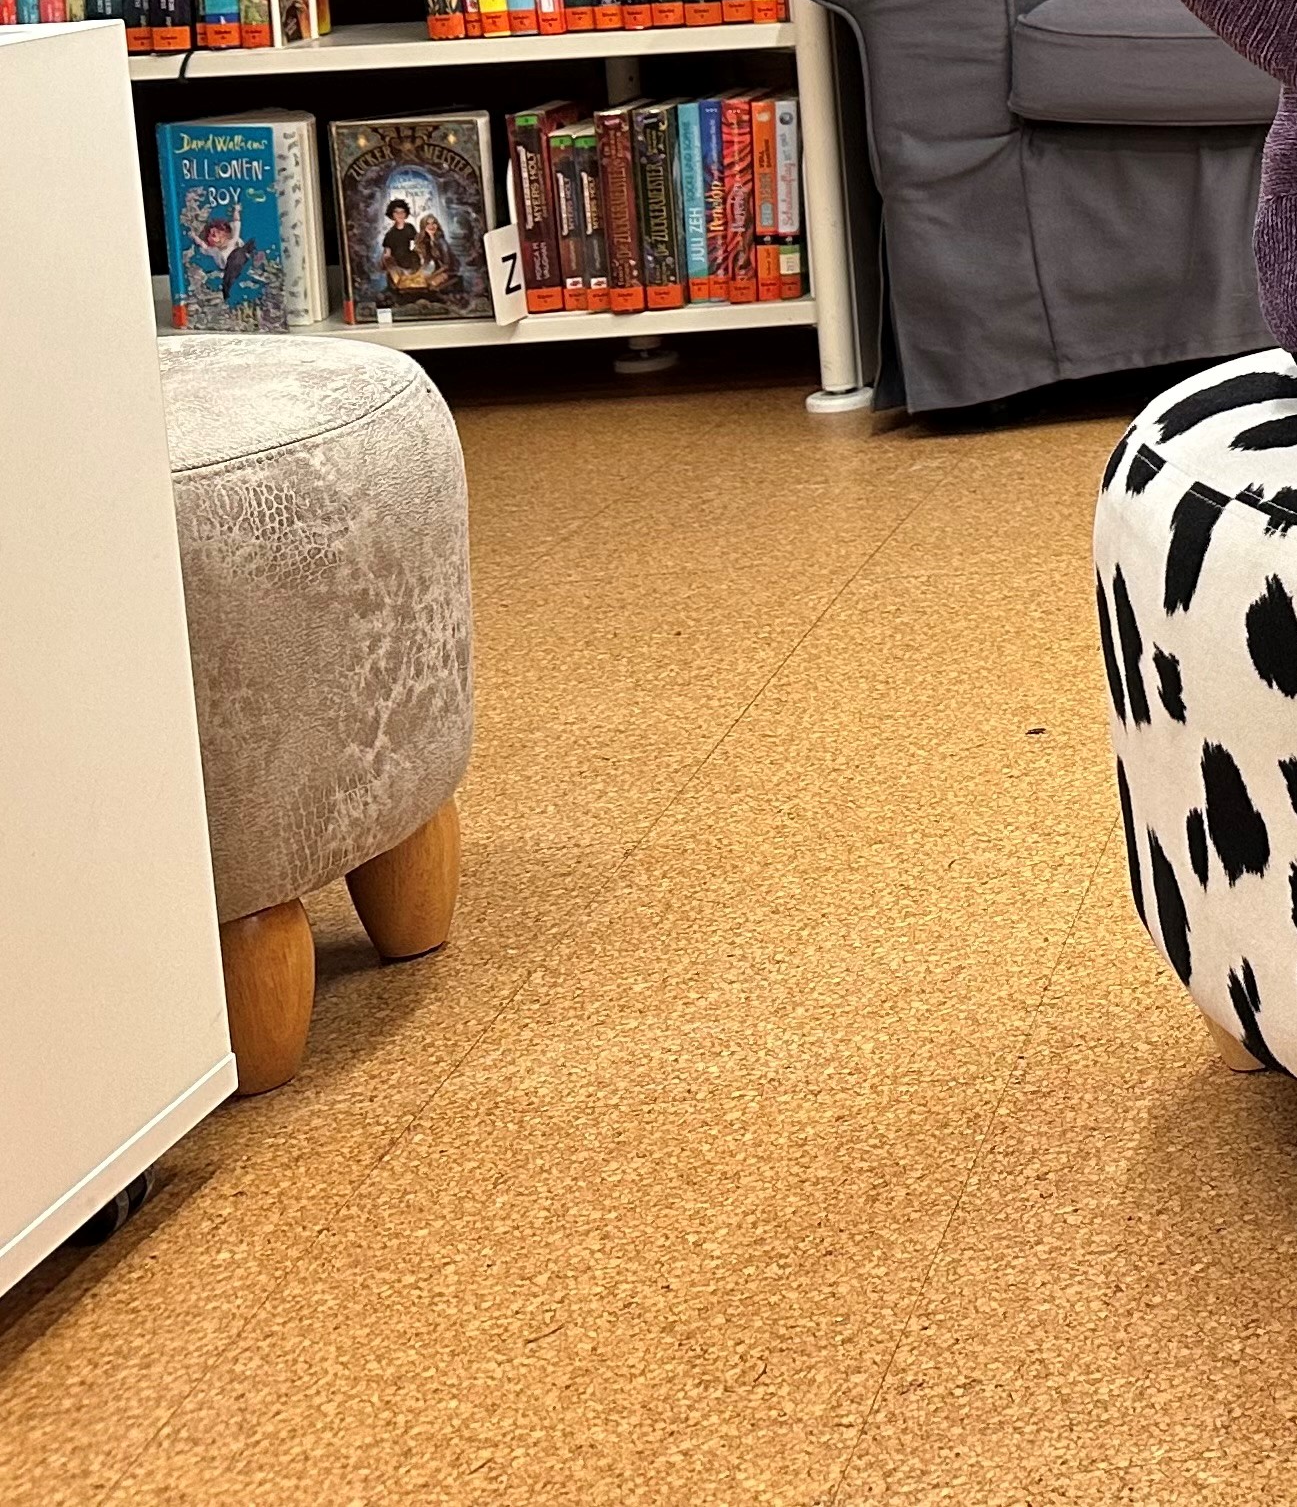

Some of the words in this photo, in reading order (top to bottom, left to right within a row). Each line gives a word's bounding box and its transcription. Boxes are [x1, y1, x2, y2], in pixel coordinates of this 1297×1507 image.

[174, 133, 216, 154] David
[350, 145, 395, 179] ZUCKER
[423, 144, 476, 179] MEISTER
[208, 186, 241, 207] BOY
[688, 206, 702, 229] ZEH
[691, 233, 705, 264] JULI
[501, 252, 522, 295] Z
